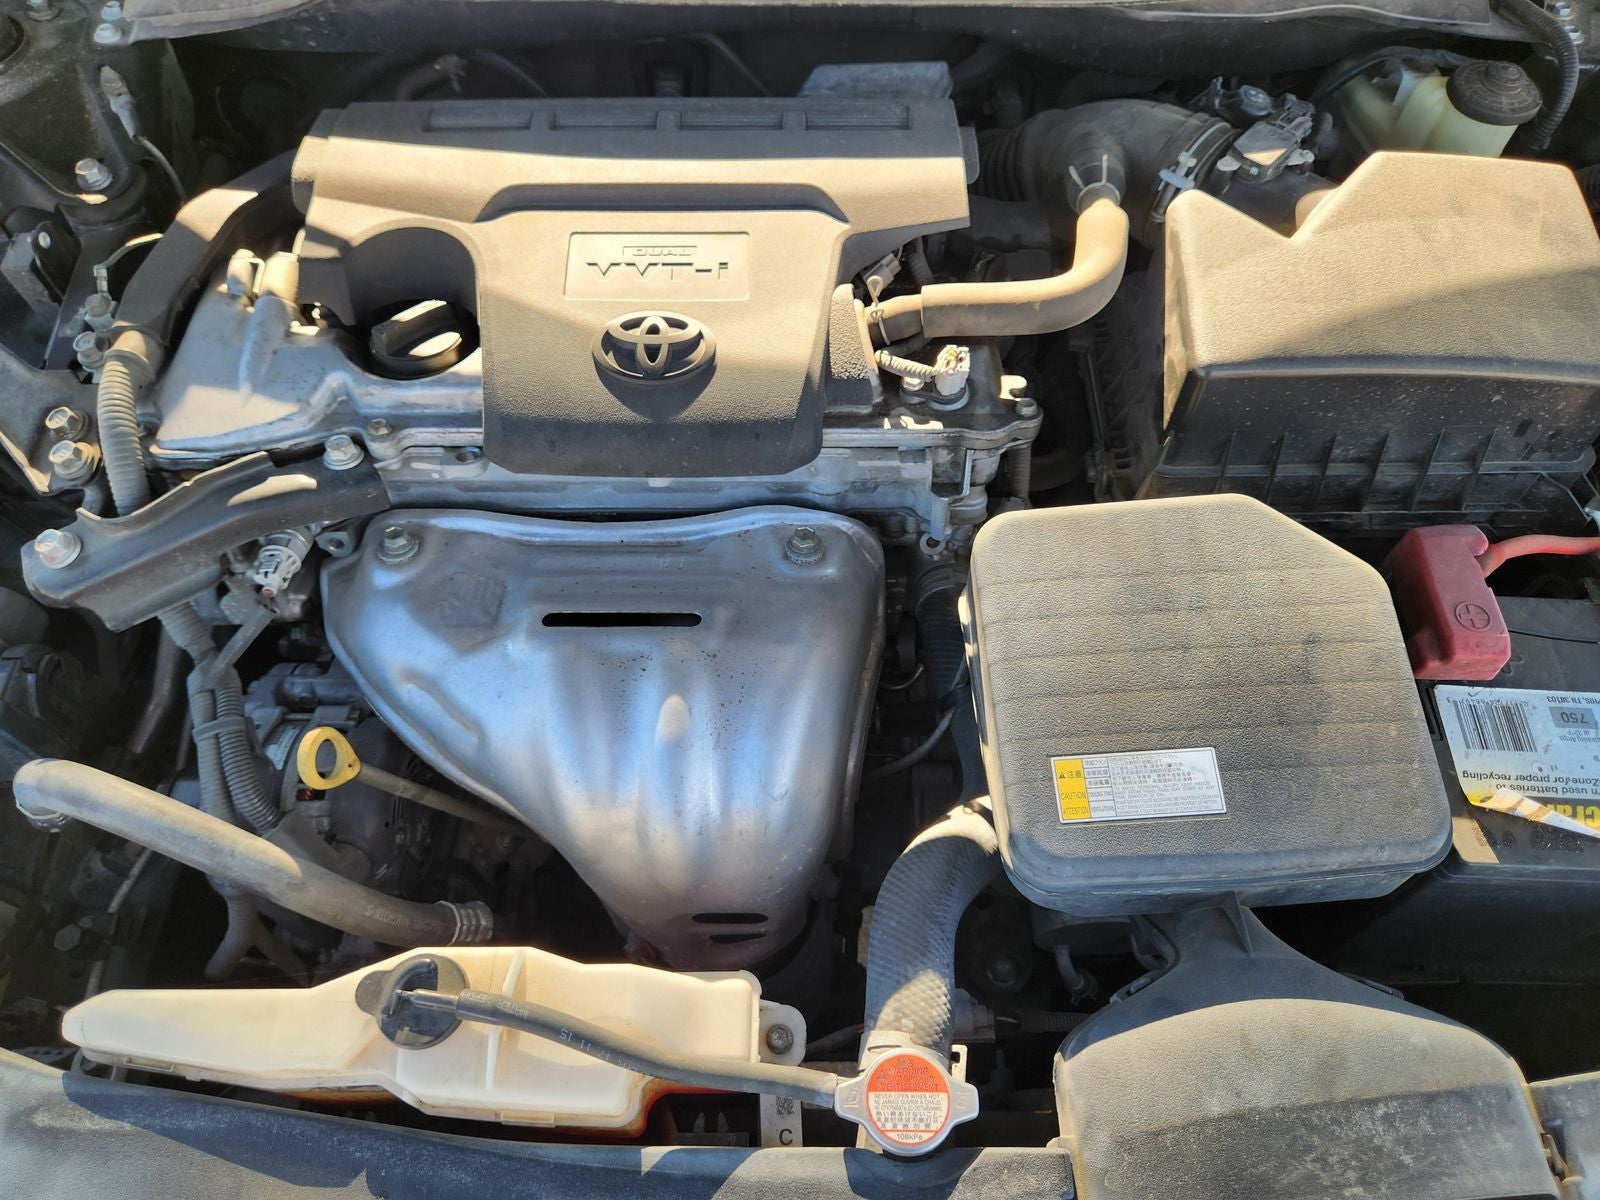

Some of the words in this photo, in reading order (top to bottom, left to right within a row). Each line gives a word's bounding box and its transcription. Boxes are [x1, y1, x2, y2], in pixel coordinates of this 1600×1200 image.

[1560, 712, 1588, 724] 750
[1462, 770, 1511, 780] recycling
[1514, 774, 1550, 783] proper
[1553, 776, 1570, 785] for
[1570, 777, 1600, 786] Zone
[1509, 784, 1558, 795] batteries
[1558, 786, 1588, 796] used
[1060, 791, 1086, 800] CAUTION
[1063, 805, 1088, 815] ATTENTION
[889, 1067, 928, 1075] WARNING
[779, 1128, 793, 1146] C
